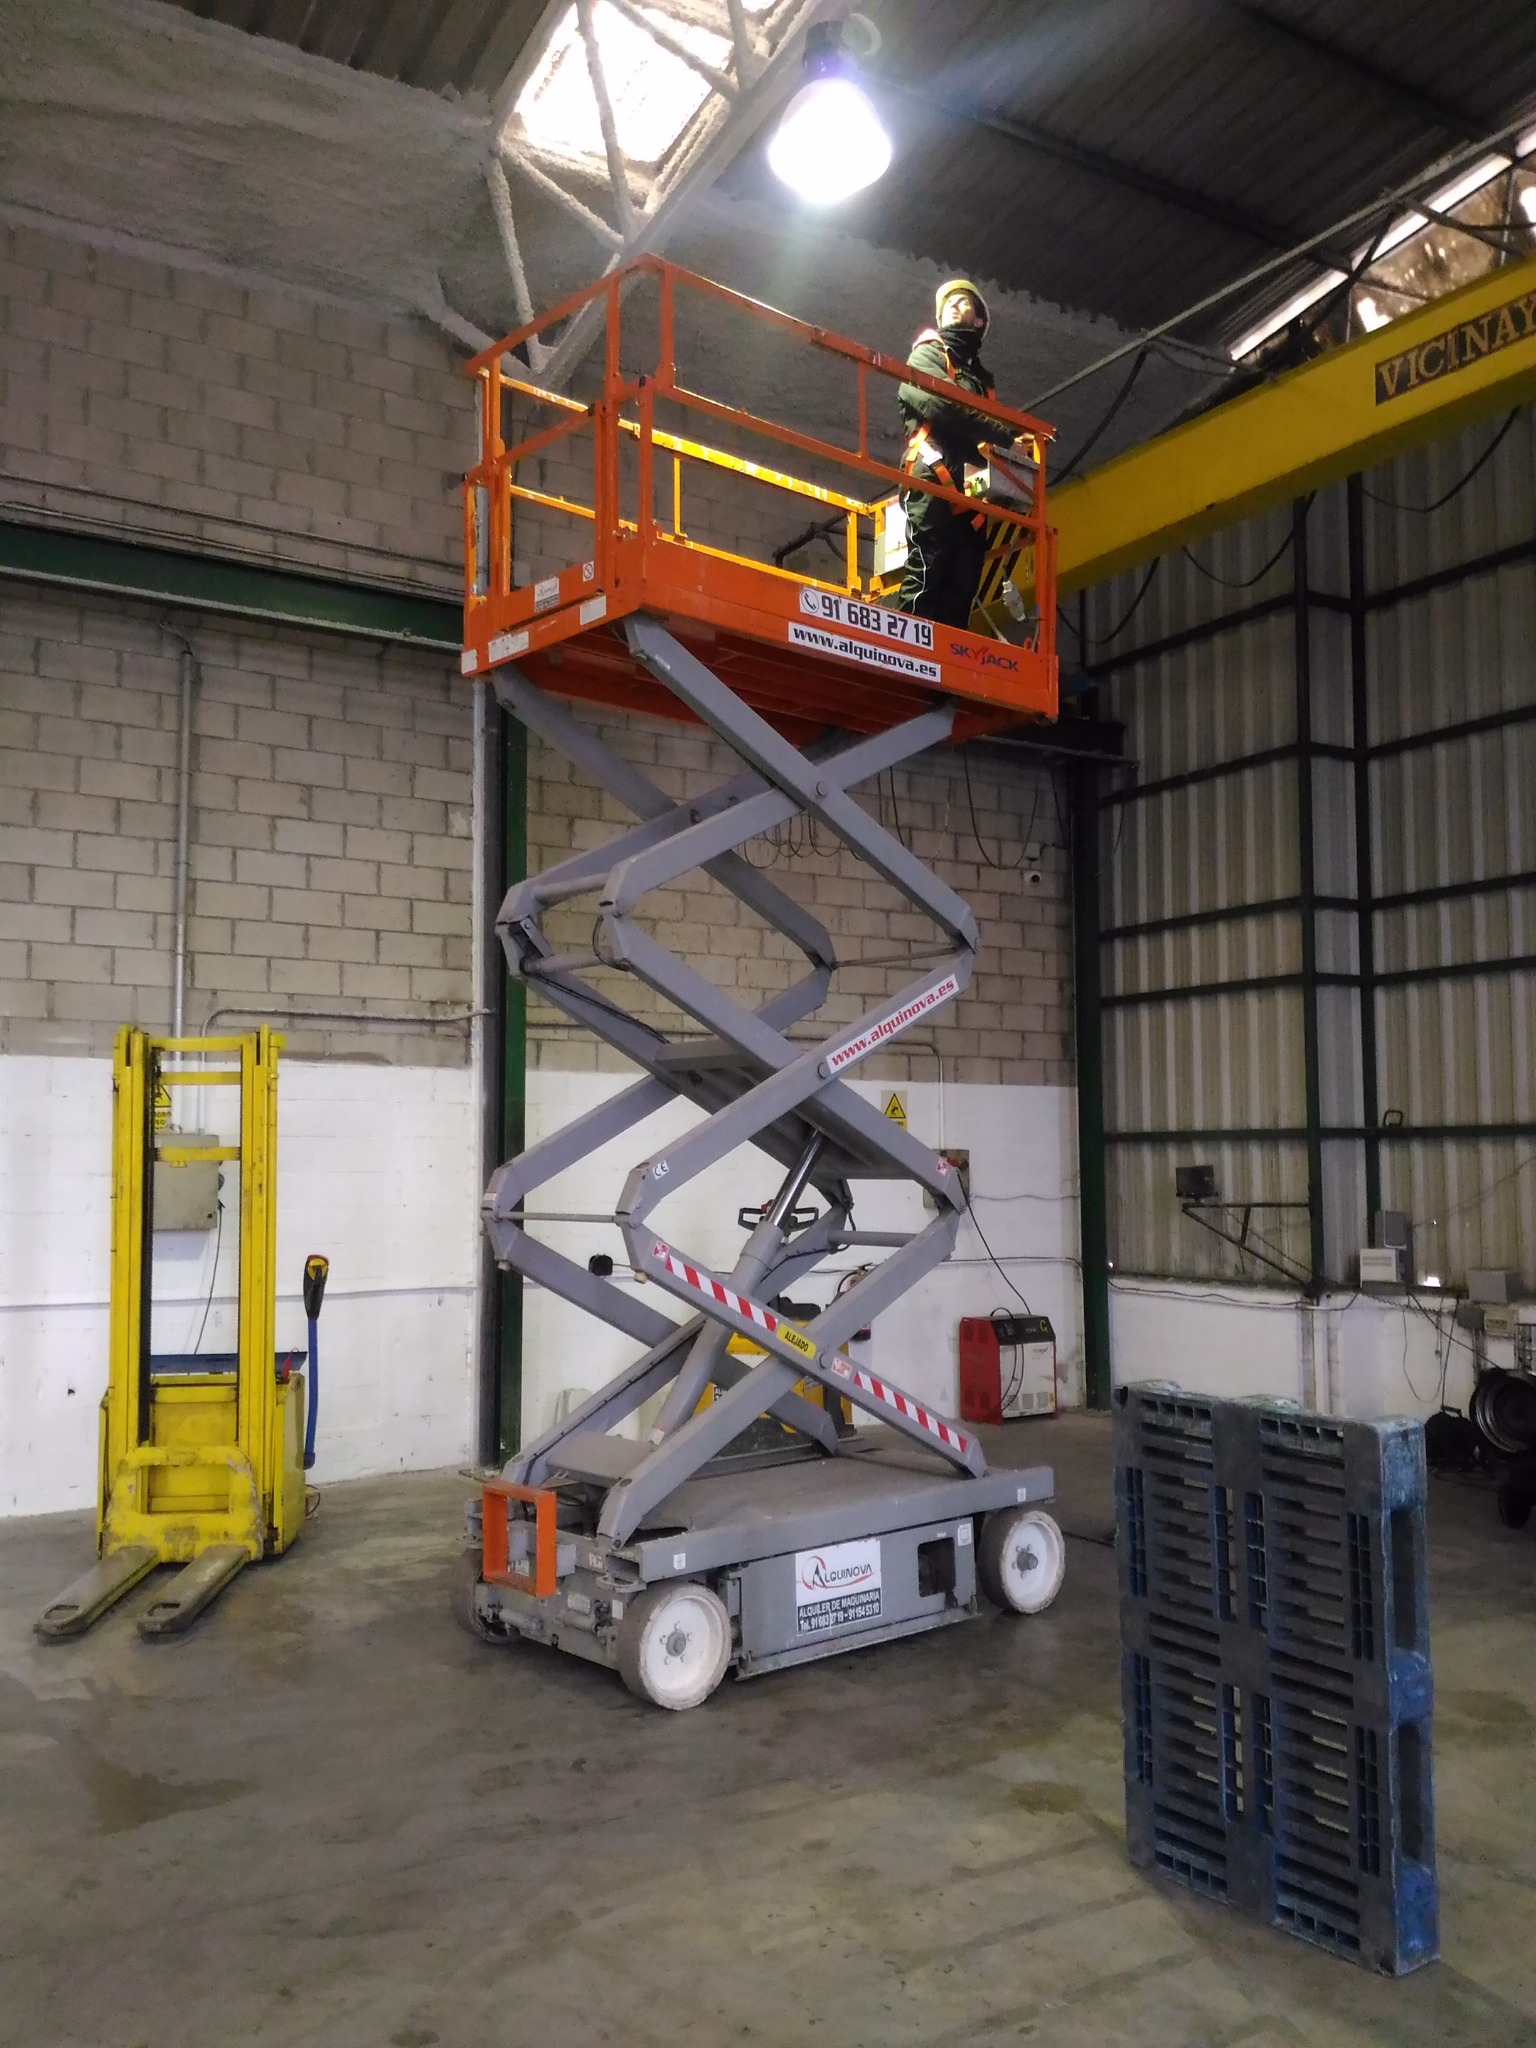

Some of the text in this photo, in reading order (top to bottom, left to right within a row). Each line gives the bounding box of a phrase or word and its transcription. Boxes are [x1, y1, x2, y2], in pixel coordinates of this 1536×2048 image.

[822, 595, 932, 647] 91 683 27 19
[793, 628, 937, 677] www.alquinova.es
[950, 643, 1019, 672] SKYJACK
[831, 980, 955, 1066] www.alquinova.es
[785, 1331, 809, 1353] ALEJADO
[799, 1591, 880, 1618] ALQUILER DE MAQUINARIA
[811, 1618, 818, 1629] 91
[848, 1609, 855, 1620] 91
[866, 1604, 873, 1616] 53
